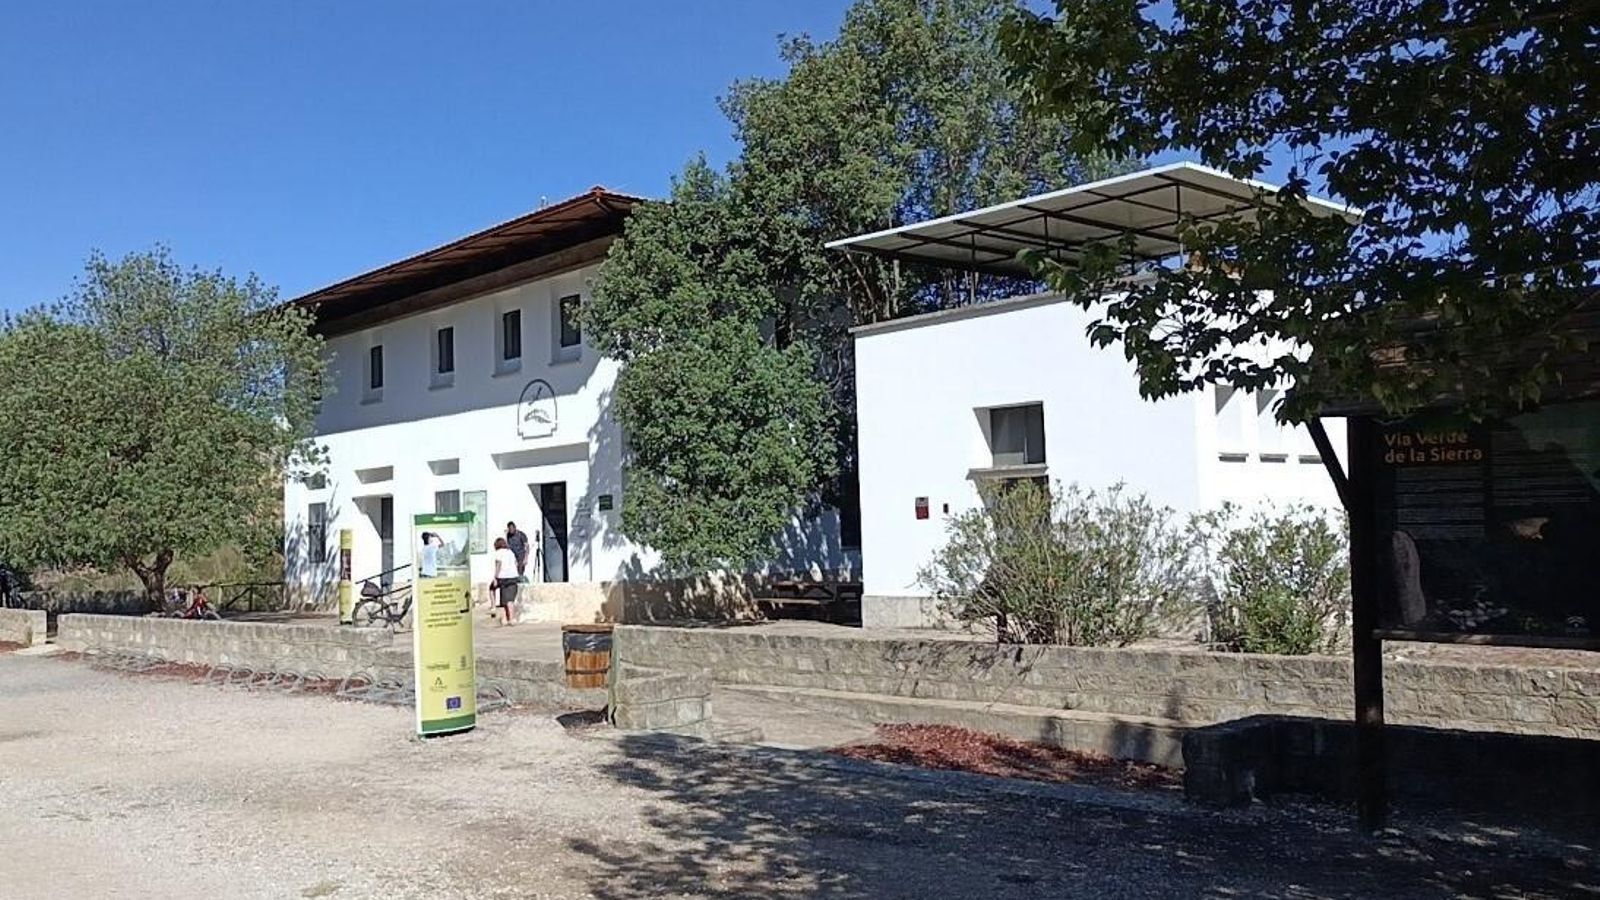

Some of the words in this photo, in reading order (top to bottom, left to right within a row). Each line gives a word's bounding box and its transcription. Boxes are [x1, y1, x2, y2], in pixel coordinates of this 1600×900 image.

[1385, 448, 1405, 462] de
[1410, 447, 1425, 461] la
[1431, 447, 1483, 461] Sierra
